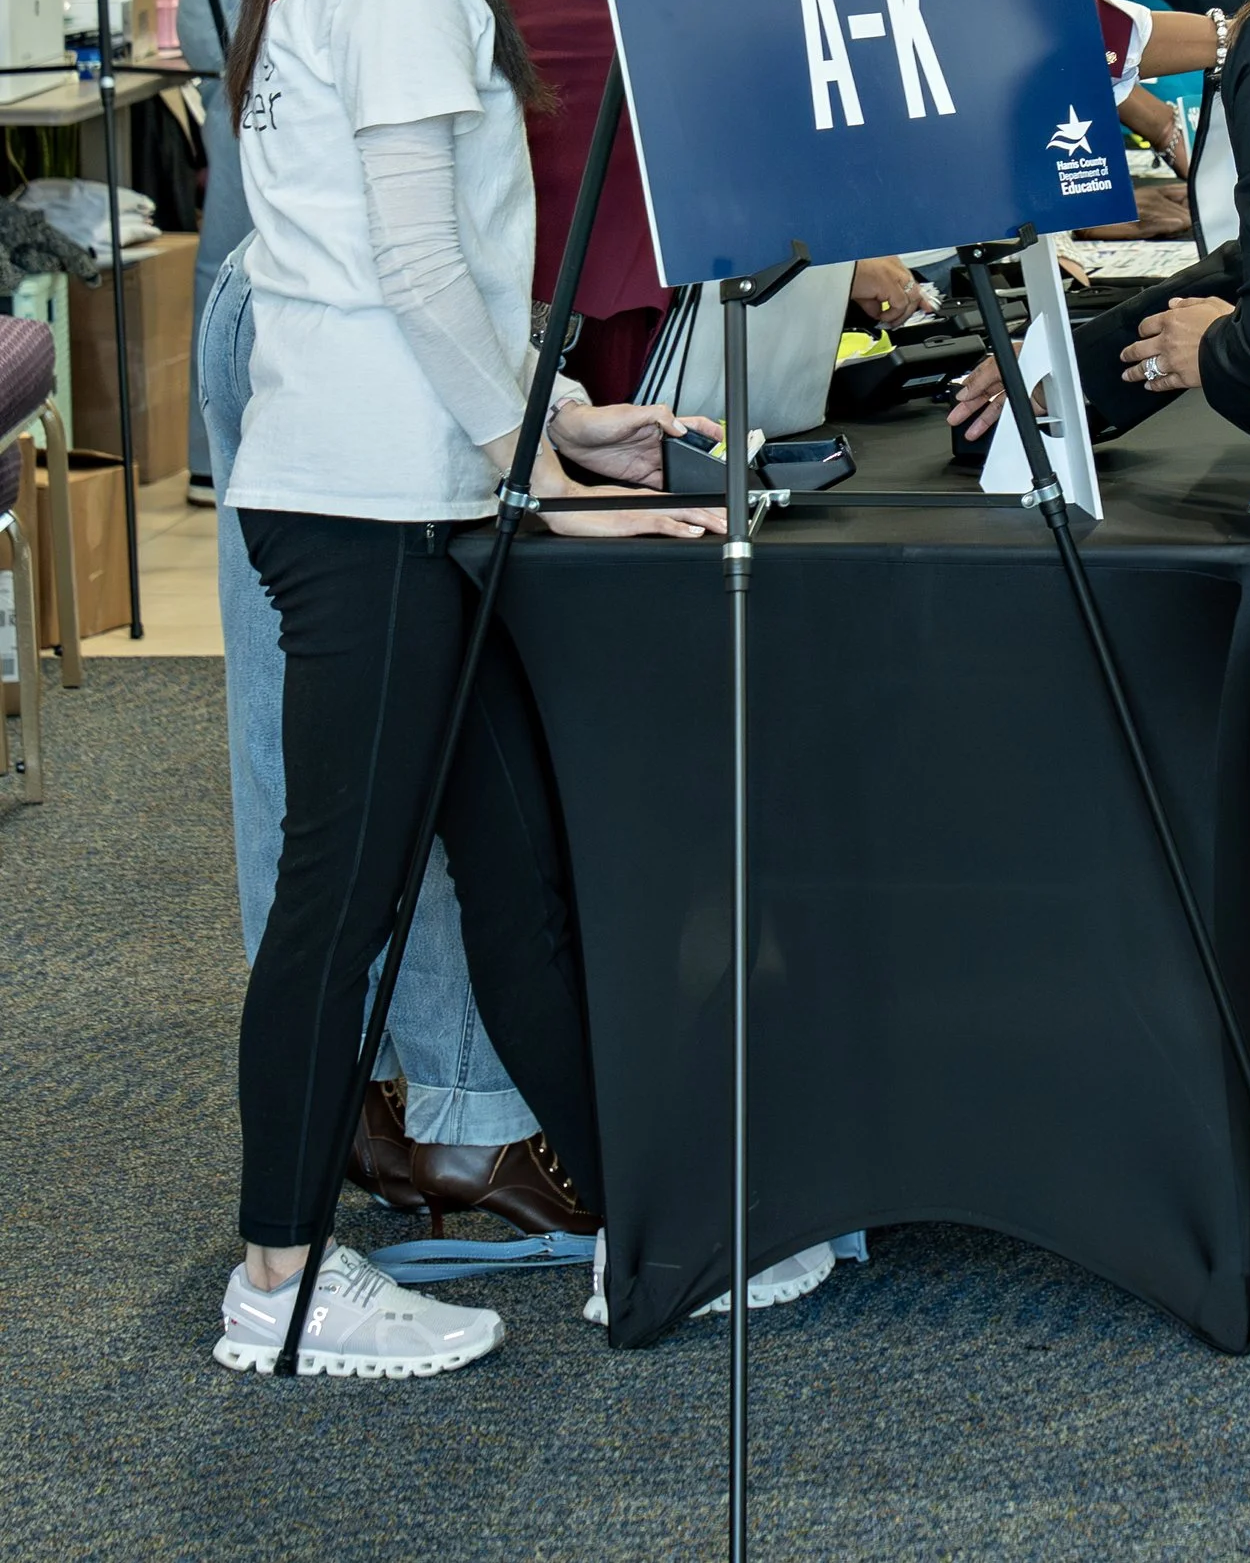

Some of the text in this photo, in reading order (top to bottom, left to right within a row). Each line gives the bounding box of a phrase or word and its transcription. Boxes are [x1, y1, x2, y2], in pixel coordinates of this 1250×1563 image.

[1056, 157, 1106, 170] Harris County
[1058, 166, 1109, 181] Department of
[1061, 178, 1112, 195] Education
